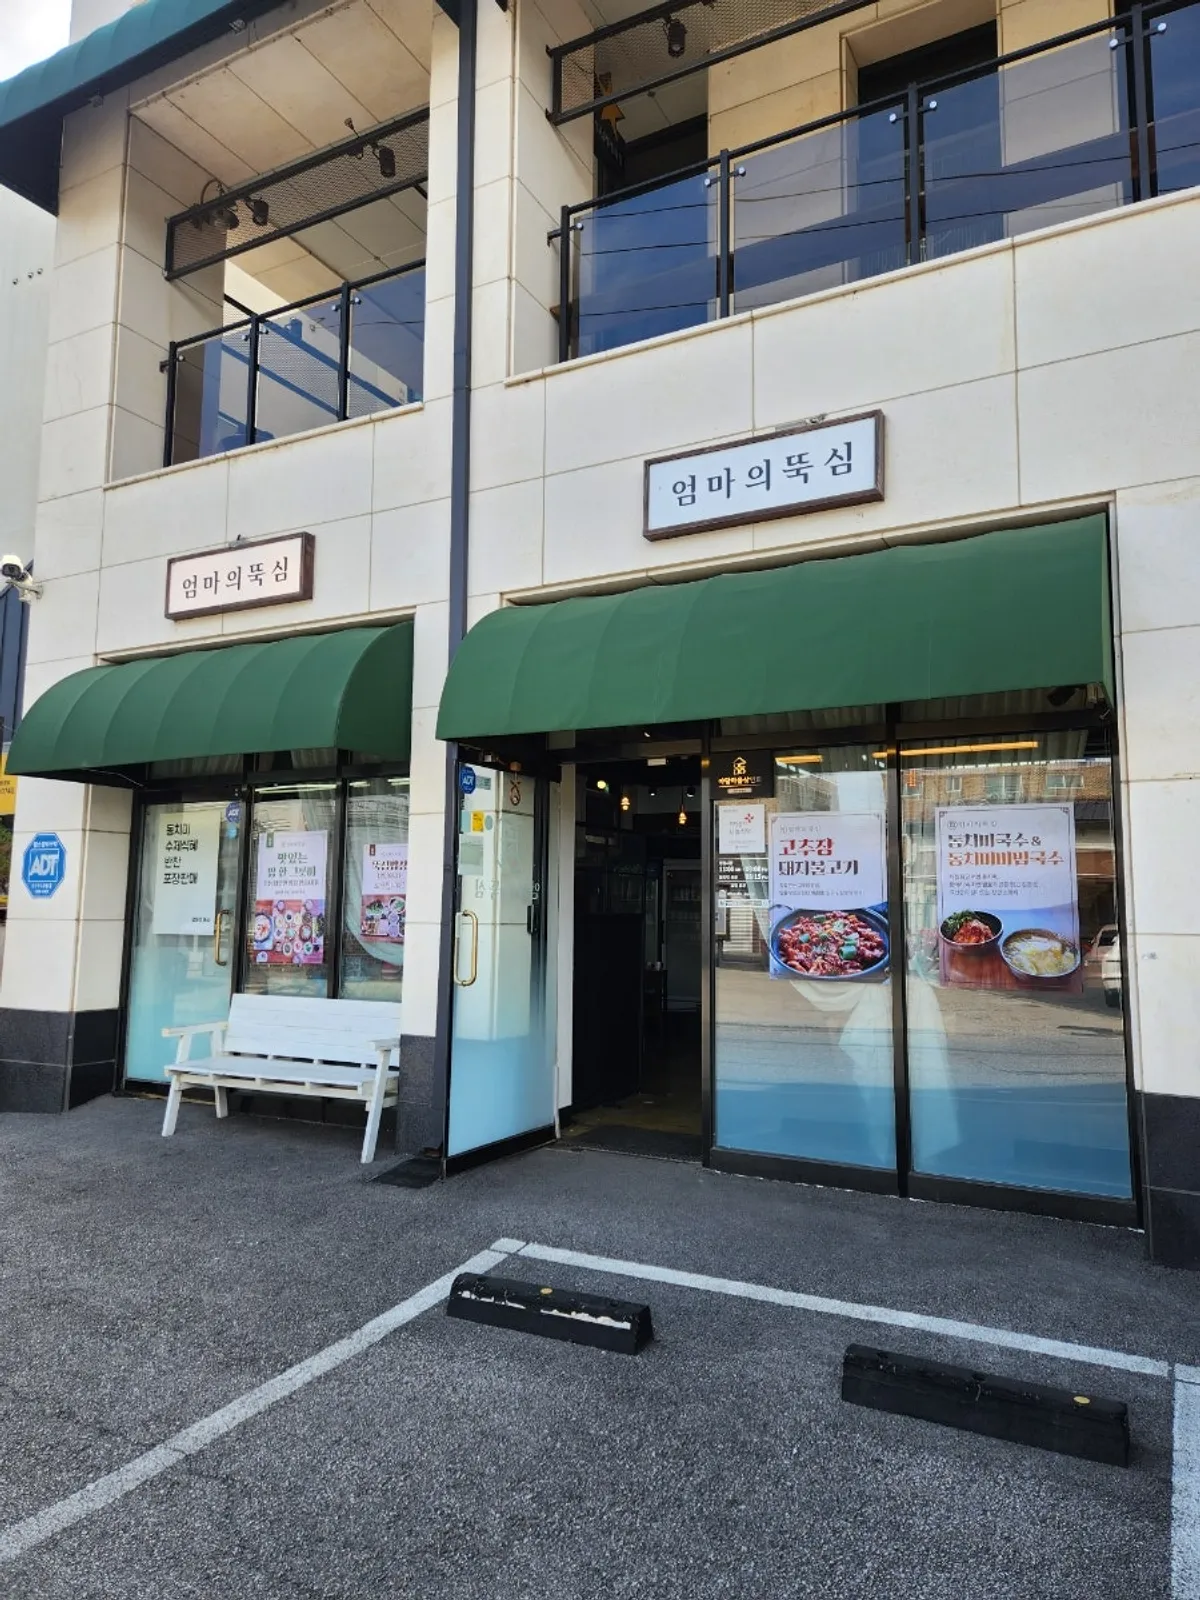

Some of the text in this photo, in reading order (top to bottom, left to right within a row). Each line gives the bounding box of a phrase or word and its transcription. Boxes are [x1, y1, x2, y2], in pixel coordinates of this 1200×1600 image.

[672, 441, 852, 507] 엄마의뚝심
[182, 556, 288, 599] 엄마의뚝심
[166, 823, 190, 836] 동치미
[165, 839, 198, 852] 수제식혜
[779, 838, 832, 856] 고추장
[29, 853, 59, 877] ADT
[277, 852, 308, 864] 맛있는
[948, 851, 1064, 867] 동치미비빔국수
[779, 860, 858, 876] 돼지불고기
[163, 872, 198, 885] 포장판매
